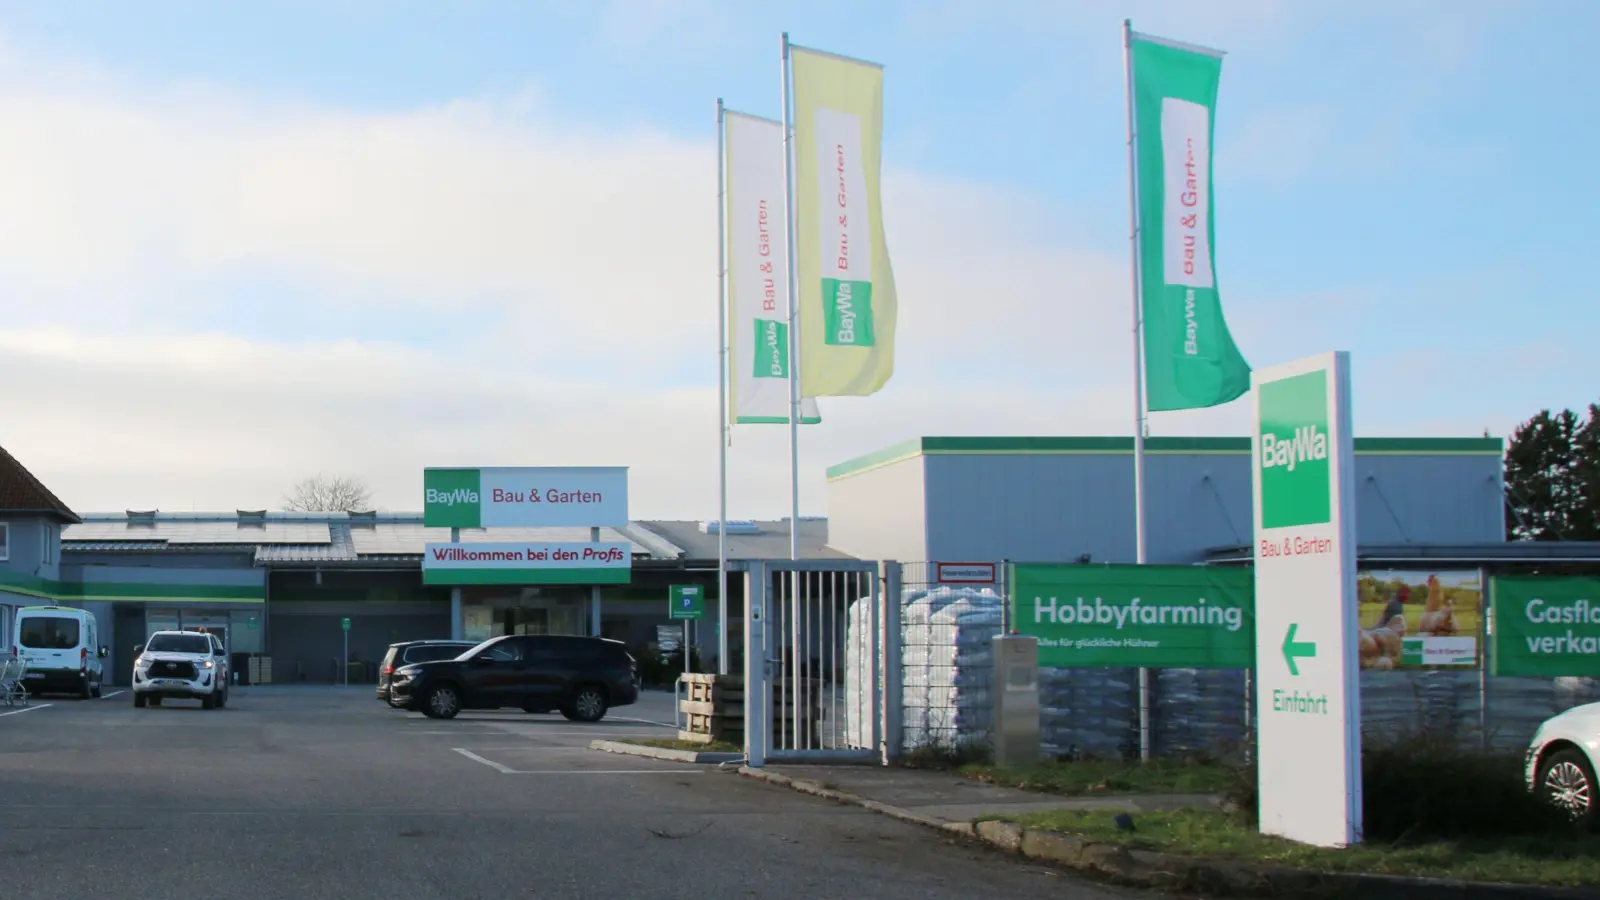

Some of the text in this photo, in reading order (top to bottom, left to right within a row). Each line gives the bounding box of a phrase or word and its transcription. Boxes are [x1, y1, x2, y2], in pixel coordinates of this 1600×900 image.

[1180, 213, 1197, 229] &
[835, 144, 856, 343] BayWa Bau & Garten
[758, 199, 784, 376] BayWa Bau & Garten
[1184, 289, 1198, 355] BayWa
[1261, 425, 1328, 472] BayWa
[425, 488, 602, 506] BayWa Bau & Garten
[432, 547, 624, 563] Willkommen bei den Profis
[1260, 536, 1333, 558] Bau & Garten
[683, 598, 691, 608] P
[1034, 596, 1243, 632] Hobbyfarming
[1526, 629, 1600, 654] verka
[1272, 687, 1329, 716] Einfahrt
